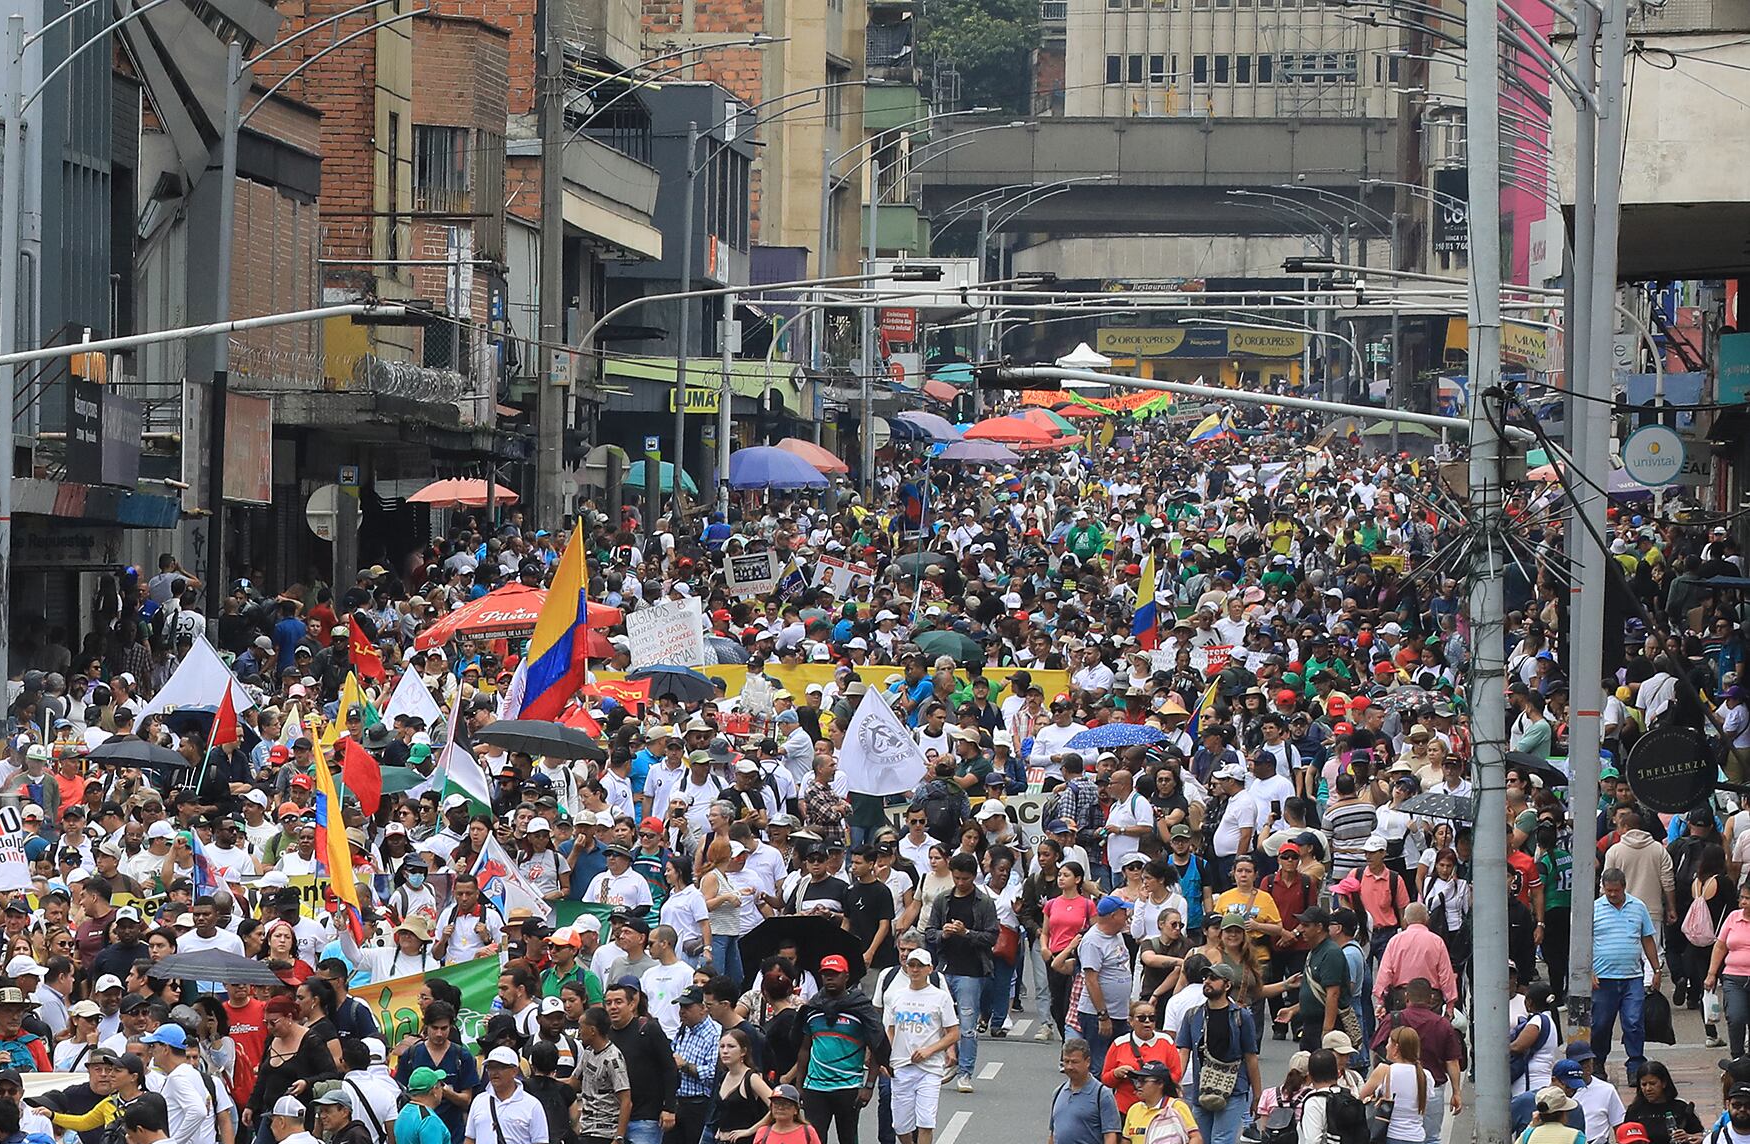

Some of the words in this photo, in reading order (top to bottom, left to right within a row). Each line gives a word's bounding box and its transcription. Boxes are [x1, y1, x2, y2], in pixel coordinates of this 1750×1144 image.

[1132, 282, 1178, 293] Restaurante
[1117, 336, 1175, 345] OROEXPRESS
[1244, 335, 1295, 345] OROEXPRESS
[1633, 456, 1676, 467] univital
[476, 609, 538, 623] Pilsen
[1637, 760, 1707, 779] INFLUENZA
[895, 1011, 932, 1025] ROCK
